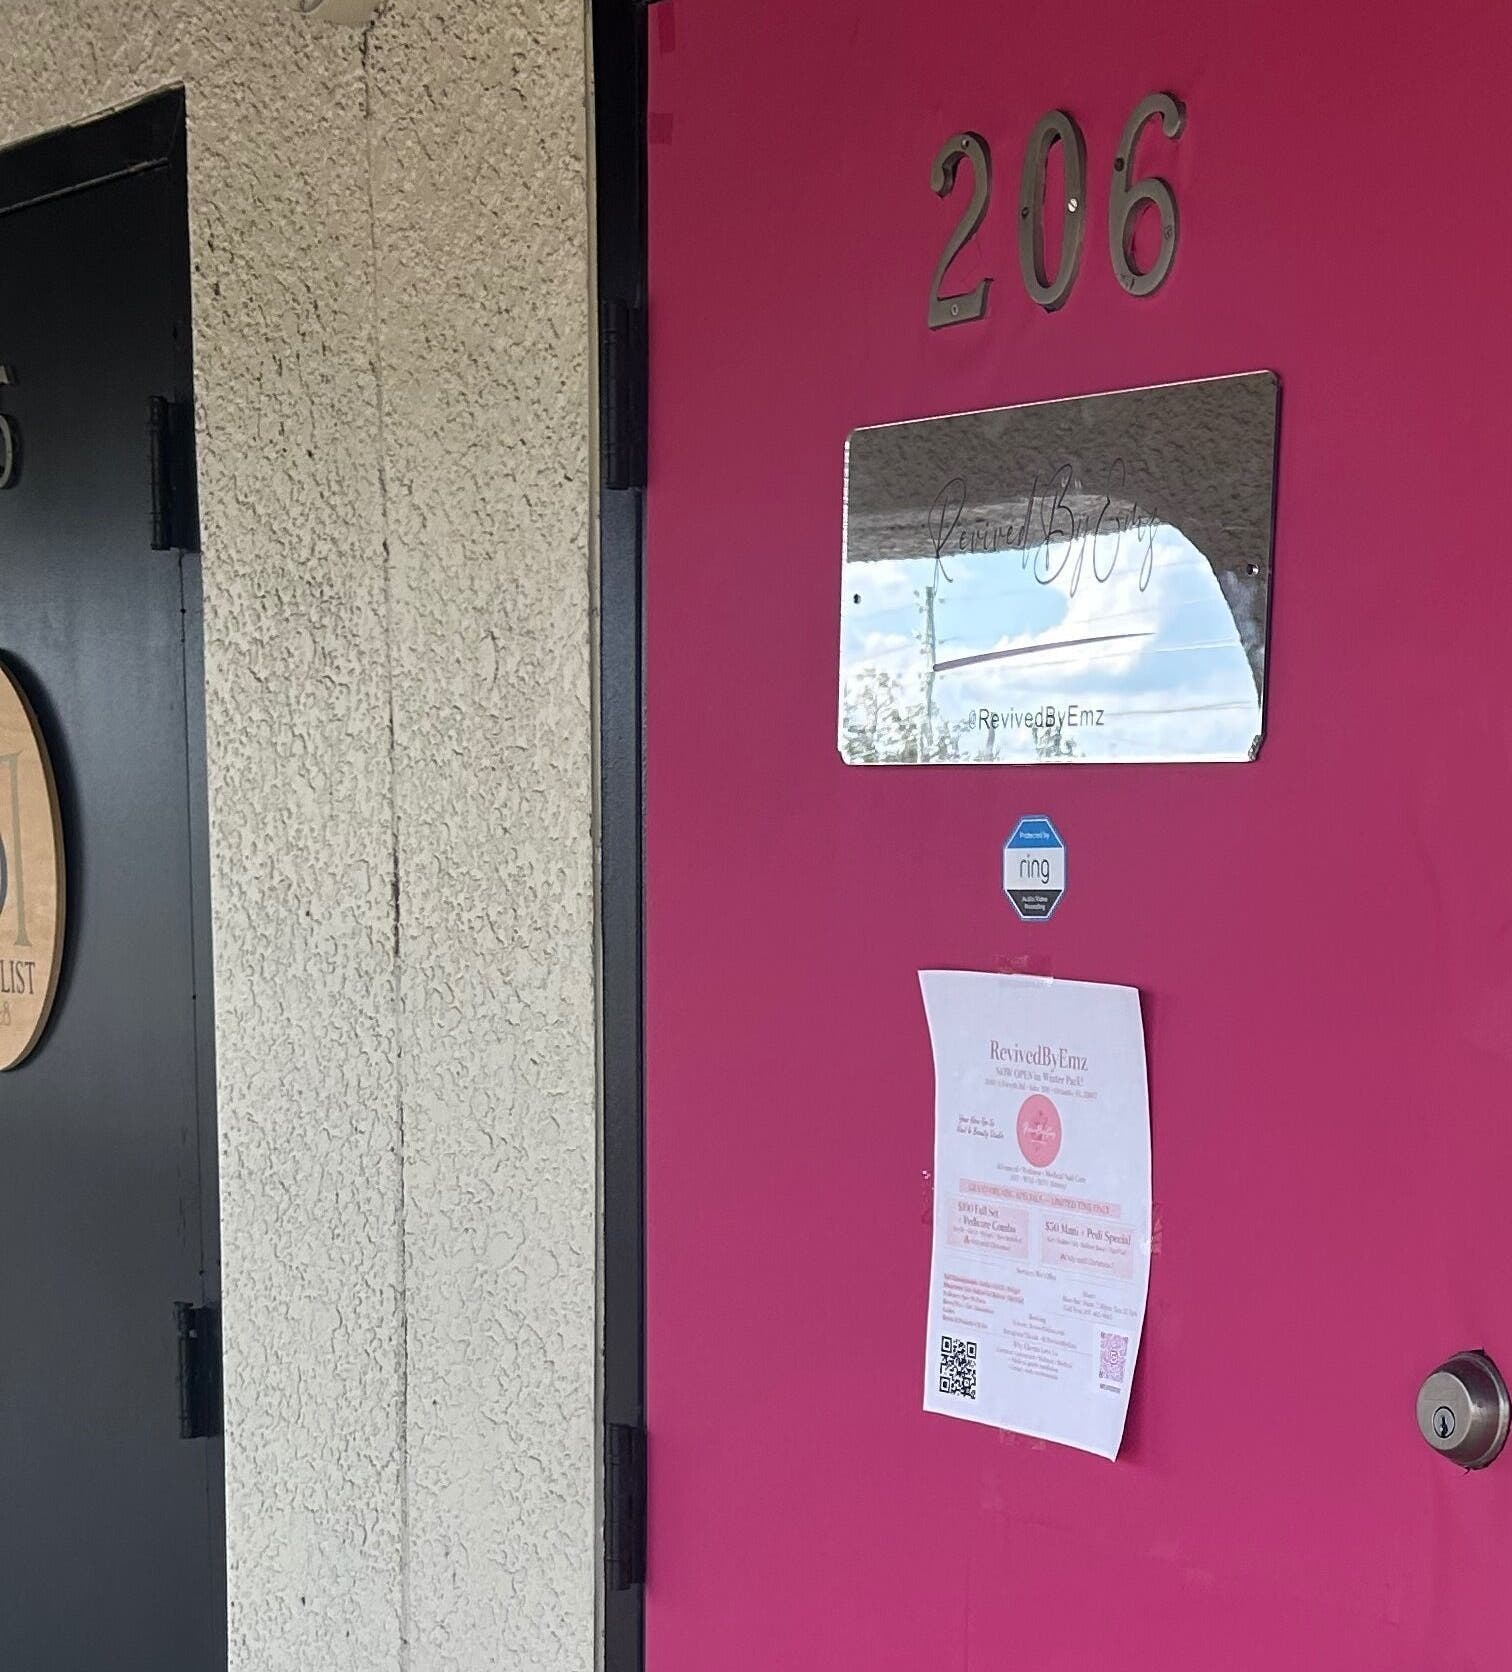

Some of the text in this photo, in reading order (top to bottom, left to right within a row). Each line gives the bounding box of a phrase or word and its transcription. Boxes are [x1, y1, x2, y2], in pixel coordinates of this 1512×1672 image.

[928, 92, 1185, 329] 206
[968, 704, 1105, 730] @RevivedByEmz
[1019, 853, 1050, 884] ring
[990, 1040, 1089, 1073] RevivedByEmz
